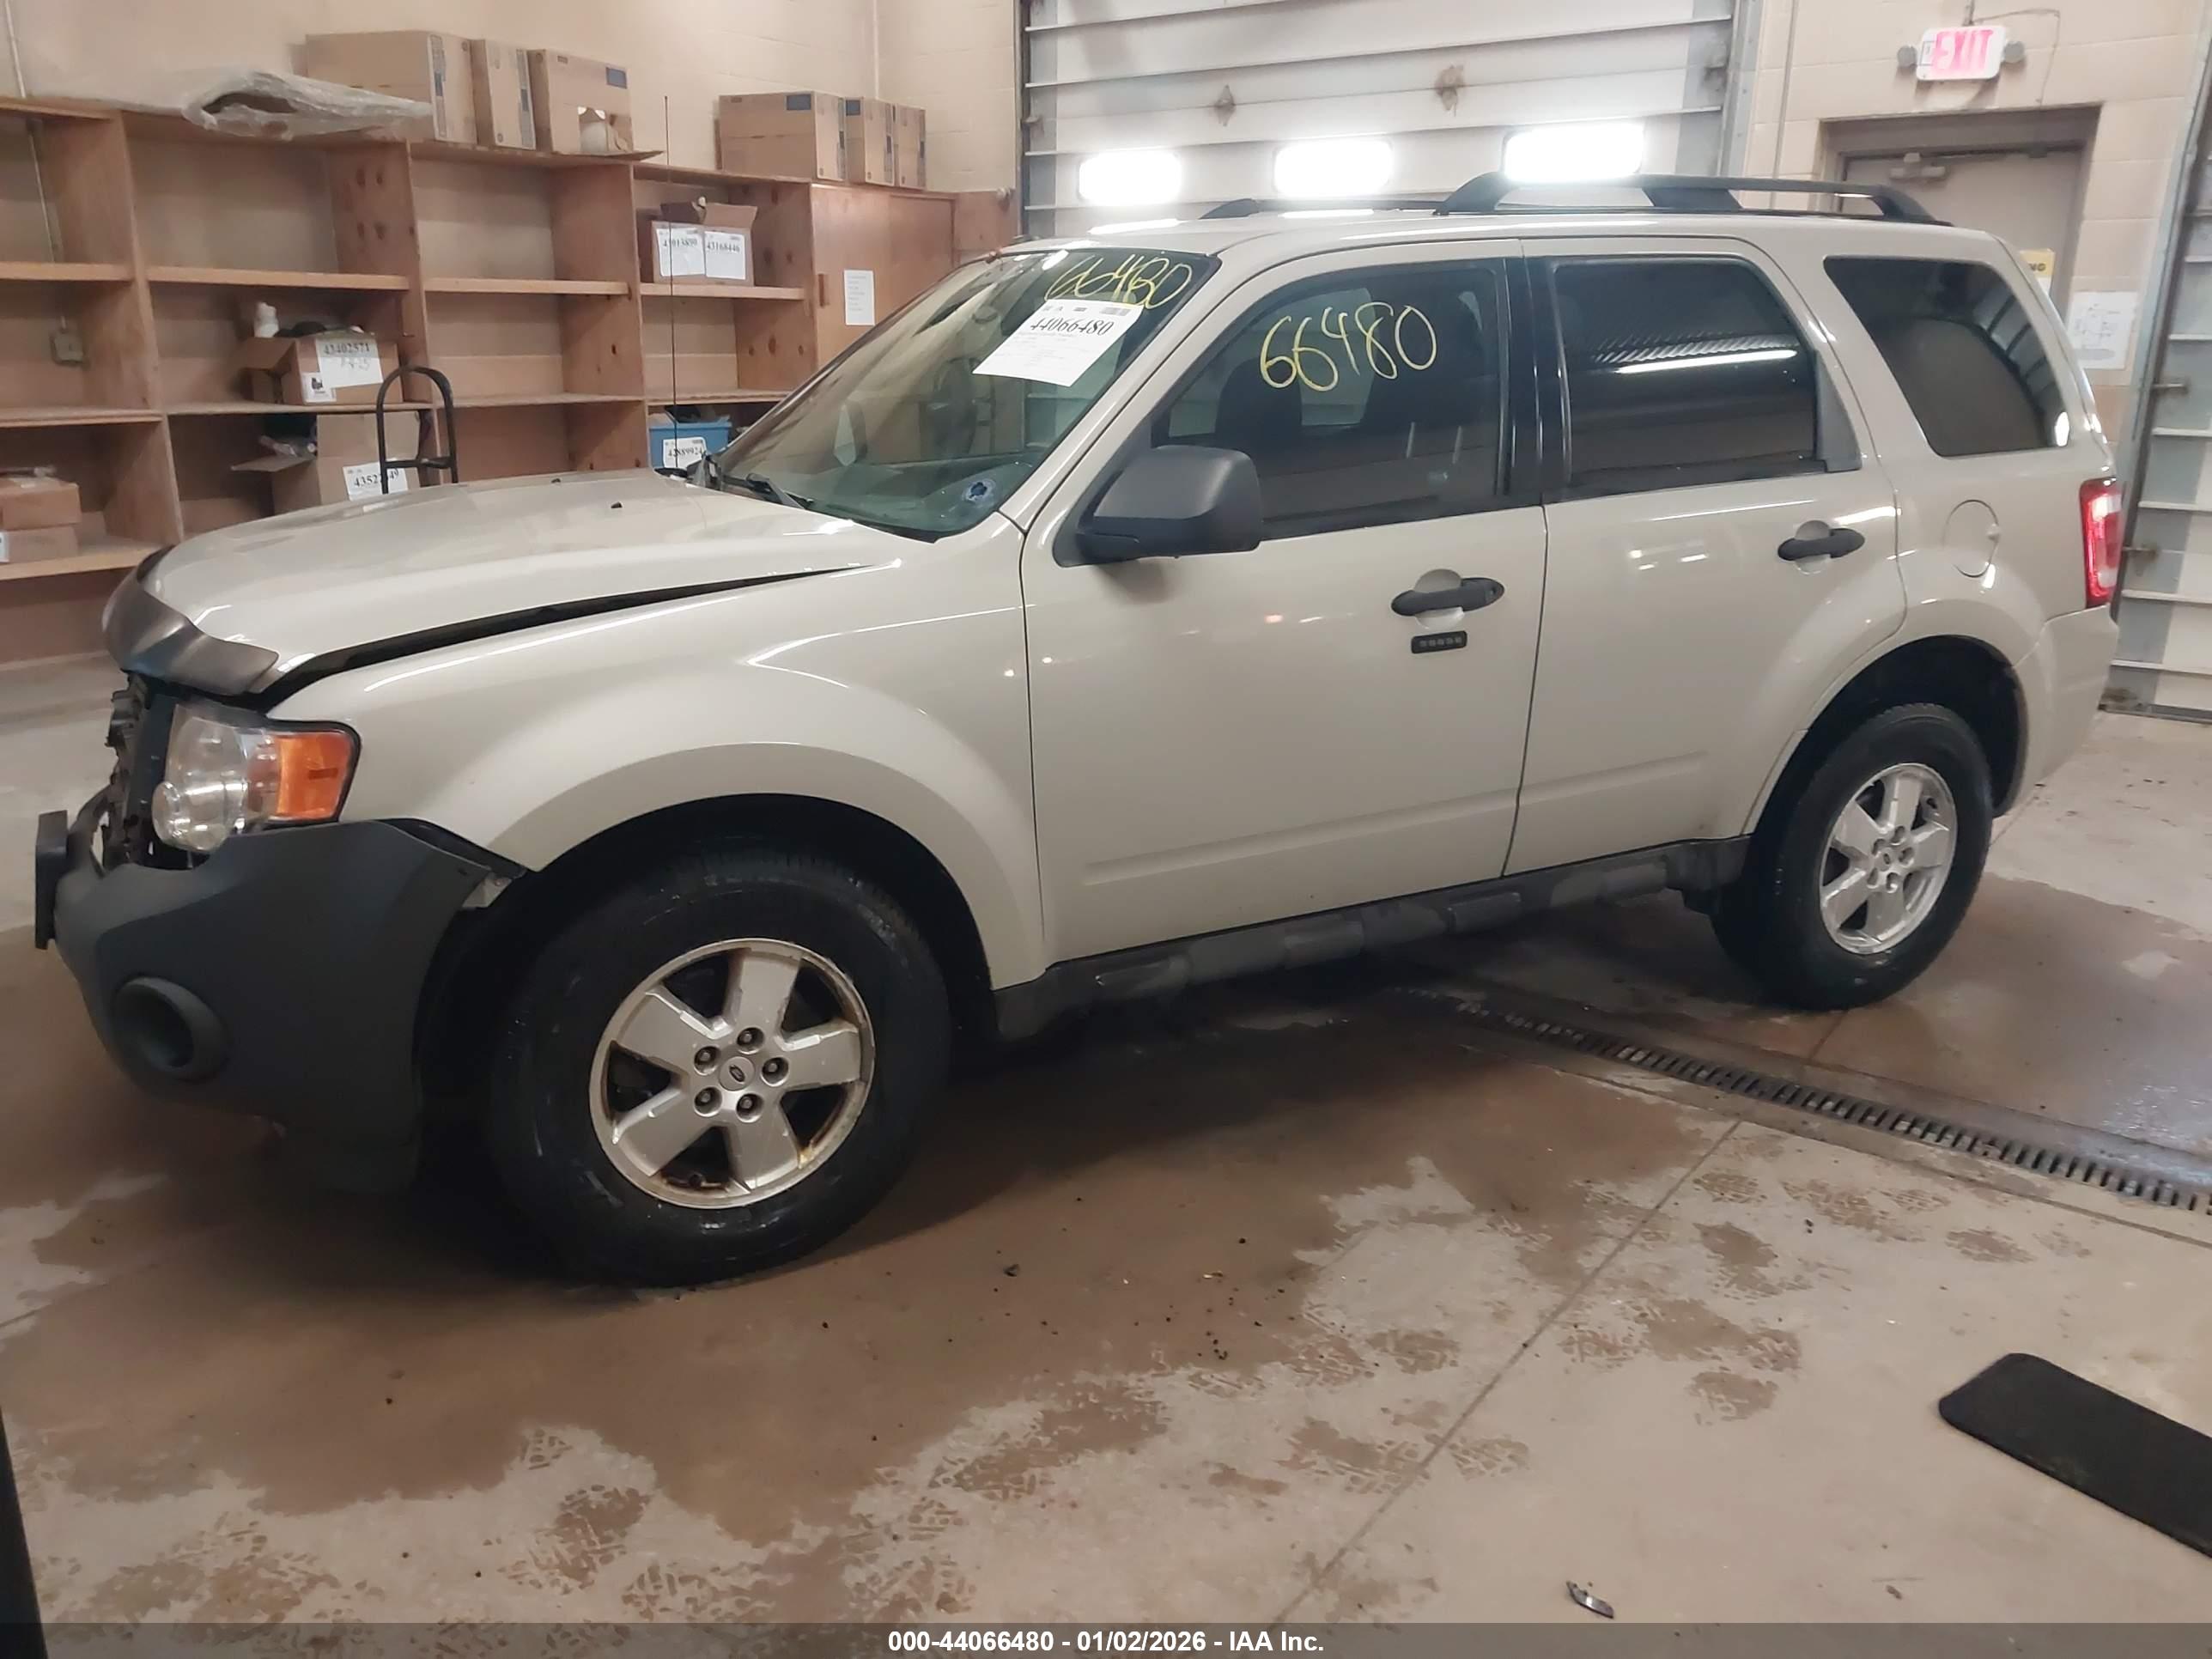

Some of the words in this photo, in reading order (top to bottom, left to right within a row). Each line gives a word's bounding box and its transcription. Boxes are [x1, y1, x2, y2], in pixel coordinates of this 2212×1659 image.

[1931, 29, 1994, 71] EXIT
[1043, 253, 1193, 310] 66480
[1030, 317, 1115, 336] 44066480
[1260, 301, 1437, 392] 66480
